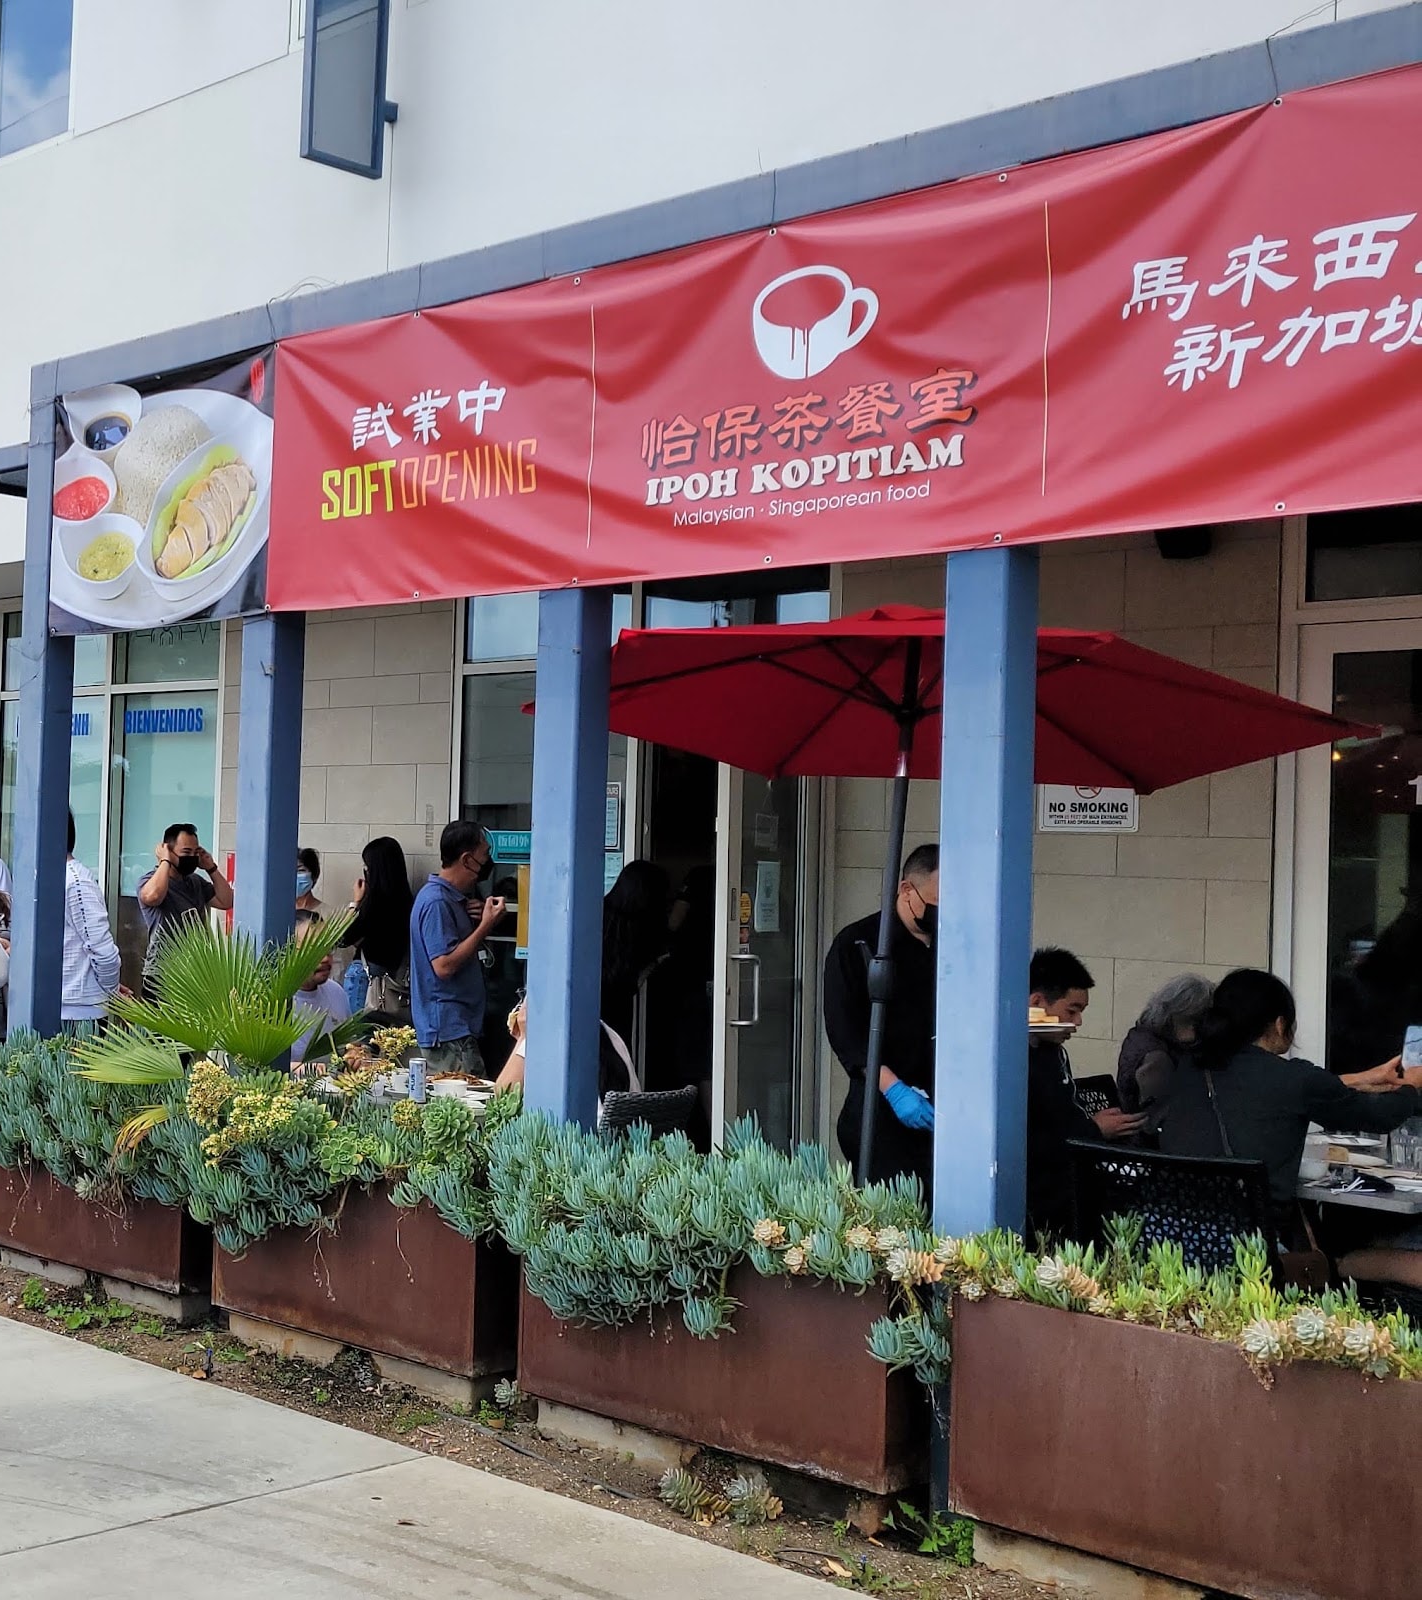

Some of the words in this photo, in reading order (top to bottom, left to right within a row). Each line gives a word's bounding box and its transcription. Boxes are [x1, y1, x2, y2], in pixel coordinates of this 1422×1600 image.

[1122, 212, 1422, 321] 馬來西
[352, 380, 506, 451] 試業中
[641, 368, 977, 469] 怡保茶餐室
[321, 460, 397, 520] SOFT
[399, 438, 538, 509] OPENING
[645, 468, 738, 505] IPOH
[750, 434, 965, 495] KOPITIAM
[673, 503, 754, 527] Malaysian
[768, 489, 881, 517] Singaporean
[886, 480, 931, 504] food
[125, 708, 203, 733] BIENVENIDOS
[1049, 802, 1066, 813] NO
[1070, 802, 1129, 813] SMOKING
